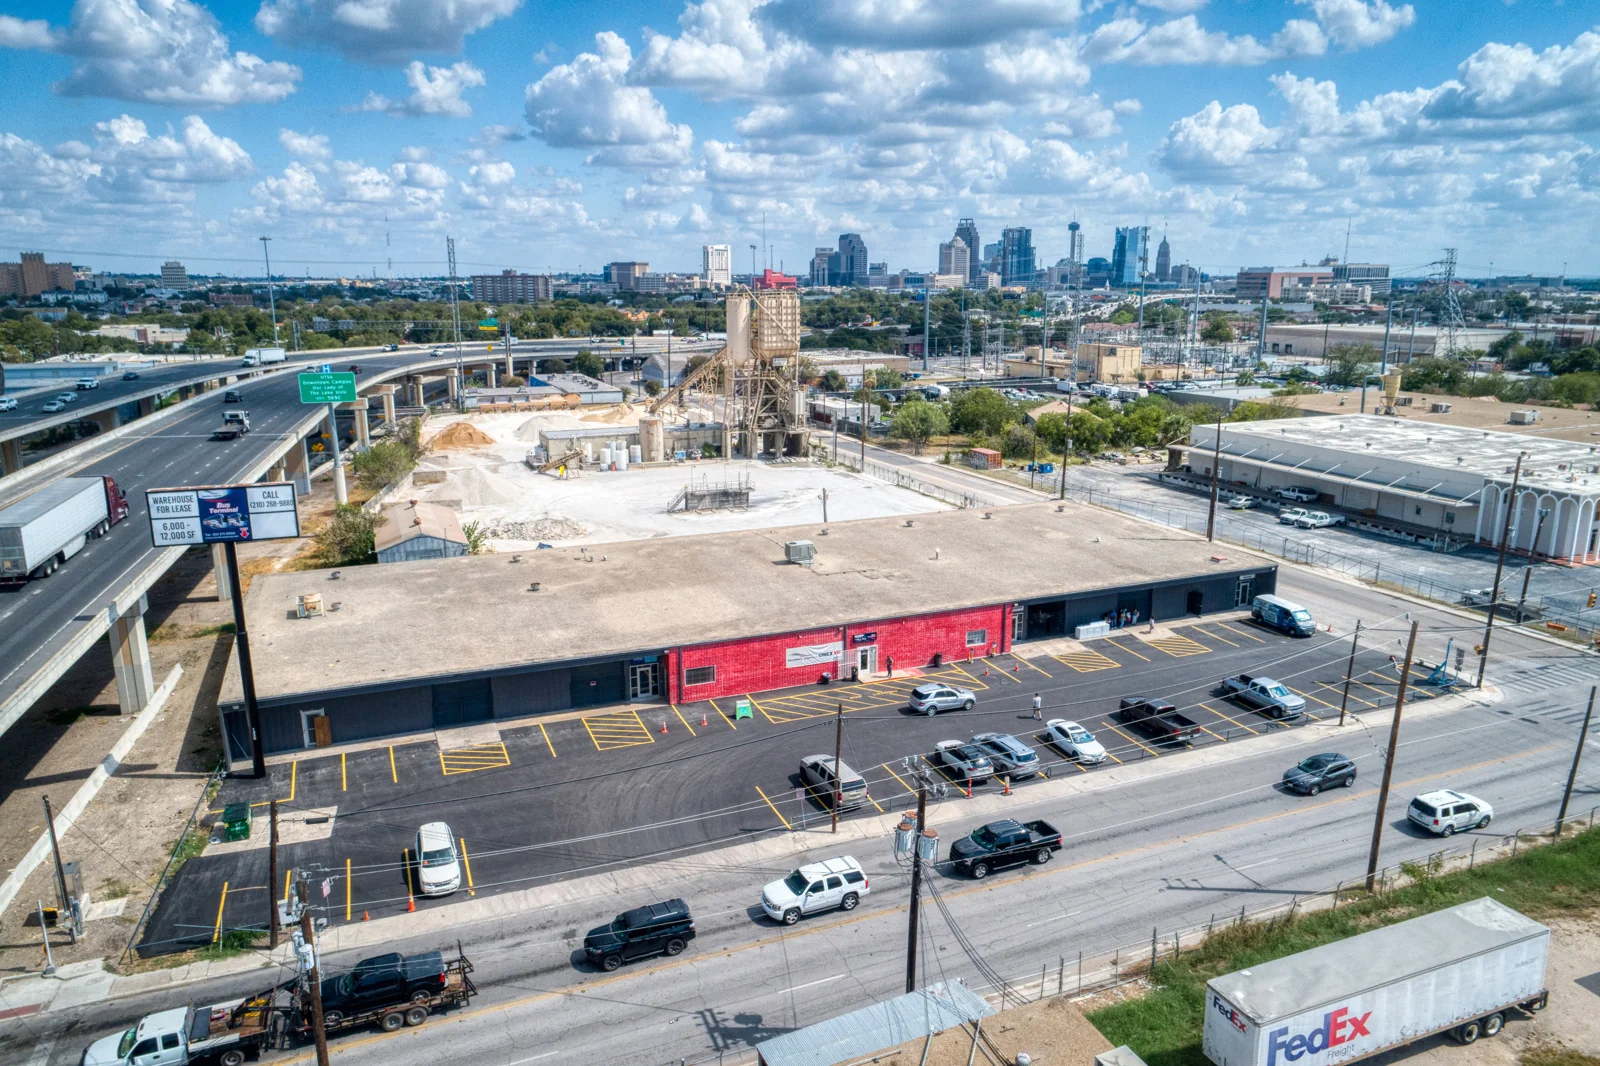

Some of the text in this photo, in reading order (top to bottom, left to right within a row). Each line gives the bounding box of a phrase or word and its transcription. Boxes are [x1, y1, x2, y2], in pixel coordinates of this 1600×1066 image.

[152, 495, 194, 504] WAREHOUSE
[262, 491, 279, 499] CALL
[157, 505, 192, 513] FOR LEASE
[250, 501, 265, 509] (210)
[162, 522, 185, 531] 6,000
[160, 532, 186, 541] 12,000
[187, 531, 196, 539] SF
[1212, 995, 1247, 1034] FedEx
[1267, 1006, 1372, 1066] FedEx
[1327, 1044, 1355, 1060] Freight
